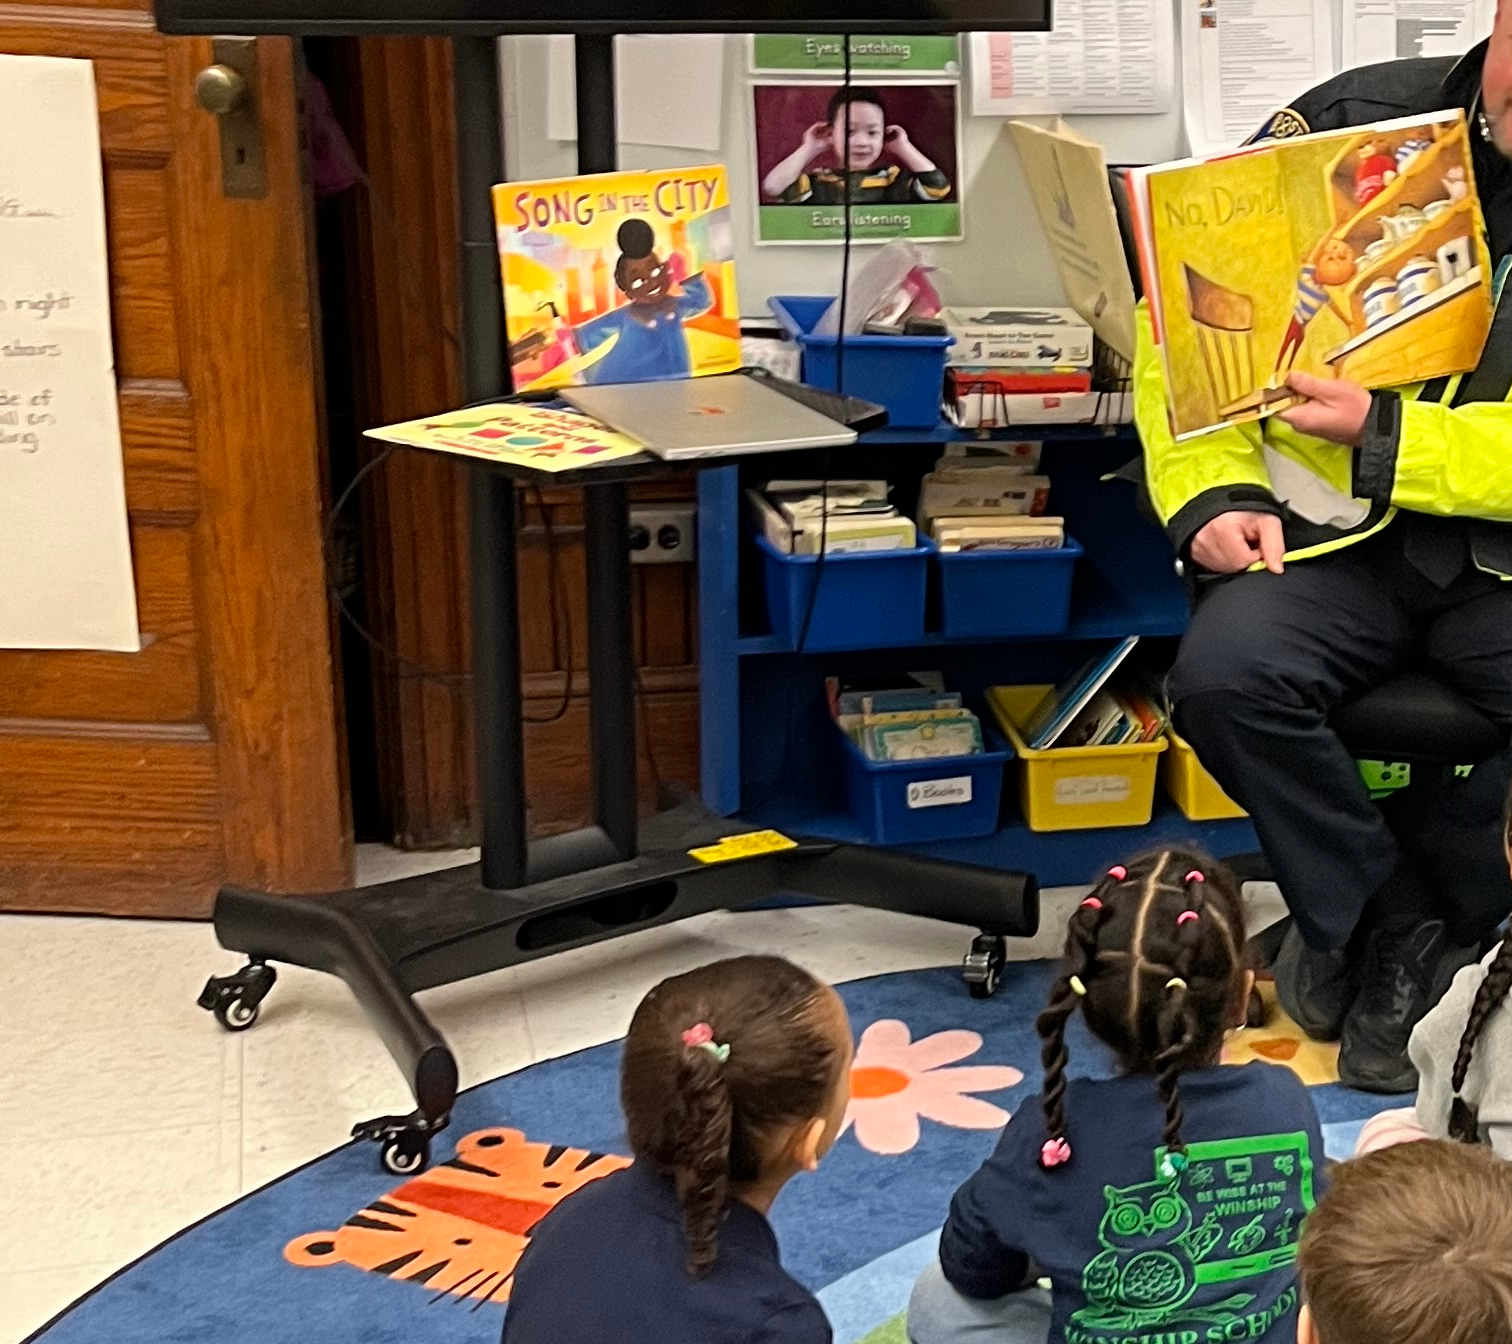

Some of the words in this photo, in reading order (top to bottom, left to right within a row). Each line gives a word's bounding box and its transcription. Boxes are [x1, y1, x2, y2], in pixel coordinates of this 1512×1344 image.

[806, 37, 842, 59] Eyes
[515, 190, 594, 233] SONG
[598, 192, 618, 214] IN
[621, 194, 651, 214] THE
[655, 178, 719, 217] CITY
[1197, 1191, 1213, 1203] BE
[1216, 1186, 1247, 1200] WISE
[1249, 1183, 1265, 1195] AT
[1266, 1181, 1287, 1193] THE
[1214, 1196, 1281, 1217] WINSHIP
